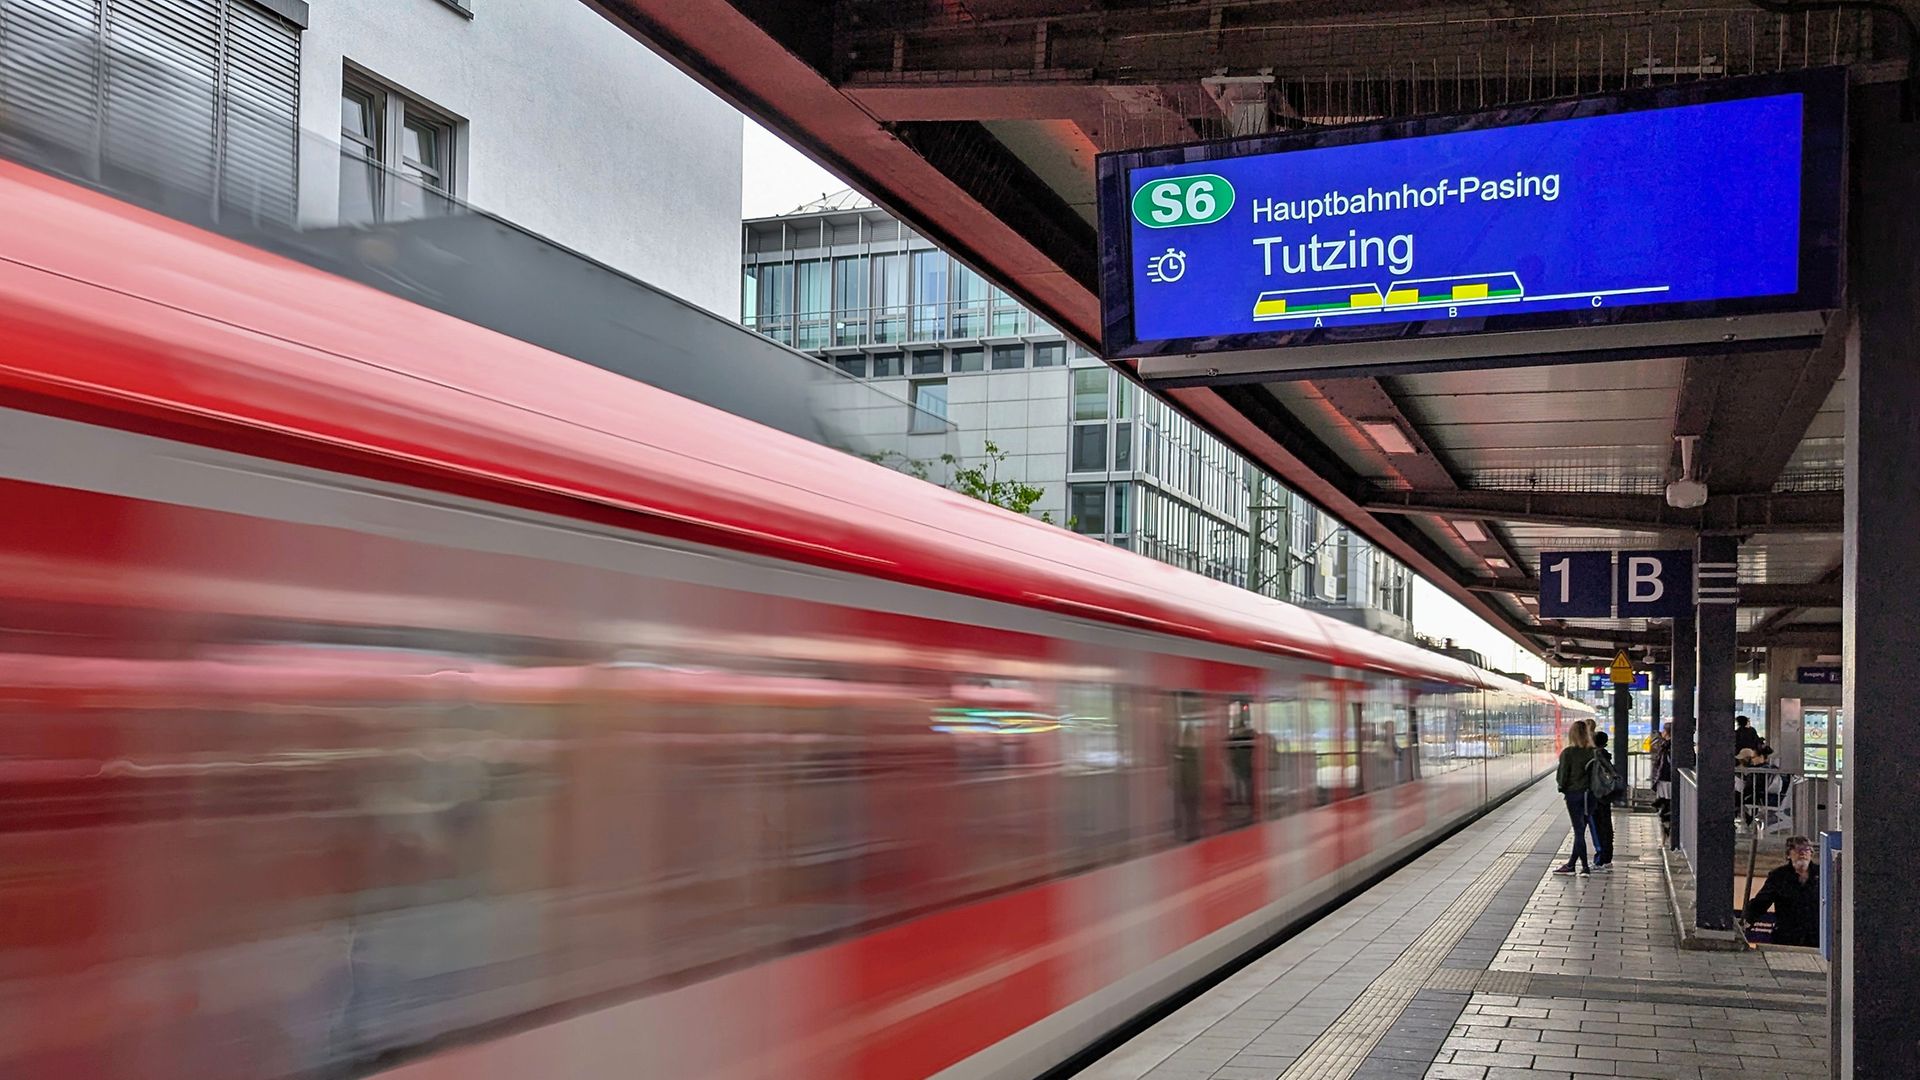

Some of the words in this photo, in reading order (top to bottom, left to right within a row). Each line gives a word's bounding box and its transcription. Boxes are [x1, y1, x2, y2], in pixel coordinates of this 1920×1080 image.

[1151, 181, 1216, 223] S6
[1253, 172, 1561, 223] Hauptbahnhof-Pasing
[1253, 229, 1414, 274] Tutzing
[1314, 317, 1323, 328] A
[1449, 307, 1458, 318] B
[1591, 296, 1602, 308] C
[1550, 558, 1570, 603] 1
[1628, 557, 1664, 603] B
